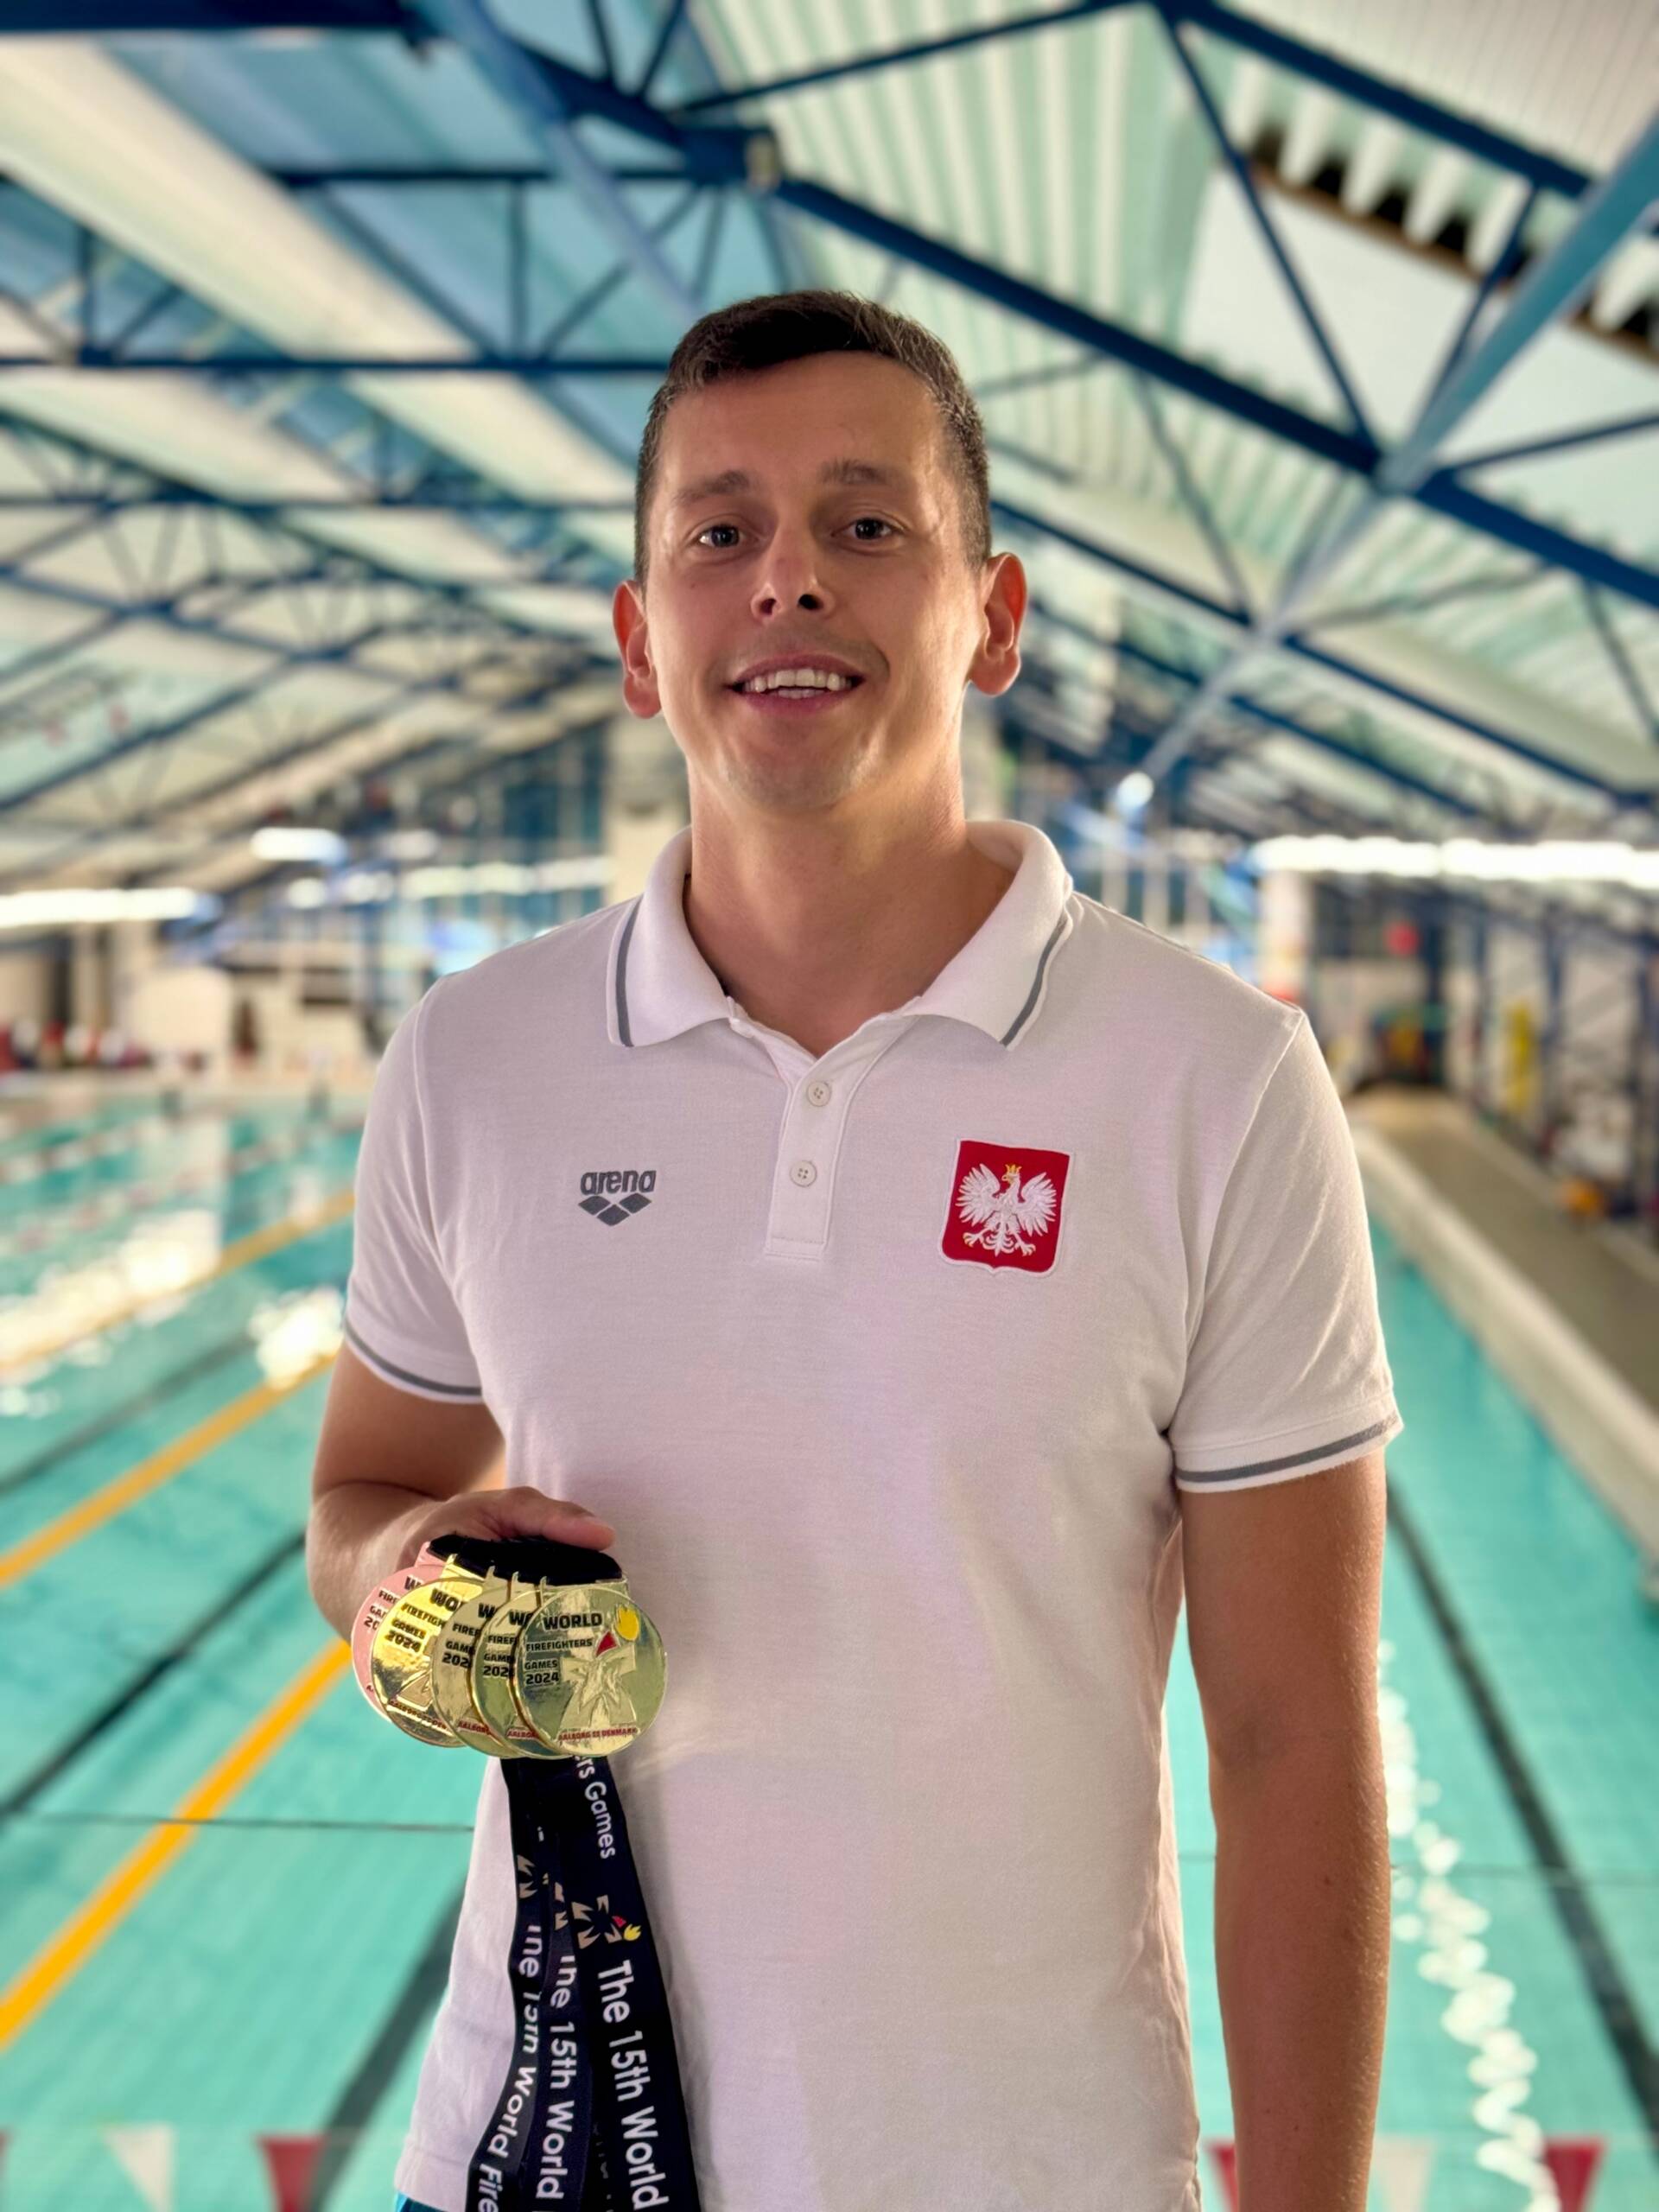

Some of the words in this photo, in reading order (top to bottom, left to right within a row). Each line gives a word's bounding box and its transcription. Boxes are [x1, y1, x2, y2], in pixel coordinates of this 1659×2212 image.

[580, 1170, 657, 1195] arena
[385, 1630, 422, 1652] 2024
[391, 1618, 427, 1640] GAMES
[543, 1613, 602, 1630] WORLD
[524, 1660, 558, 1670] GAMES
[526, 1638, 594, 1652] FIREFIGHTERS
[525, 1673, 560, 1686] 2024
[585, 1782, 616, 1859] Games
[598, 1960, 635, 2024] The
[550, 2021, 577, 2089] 15th
[609, 2031, 652, 2102] 15th
[486, 2067, 537, 2158] World
[536, 2100, 575, 2199] World
[621, 2106, 670, 2211] World
